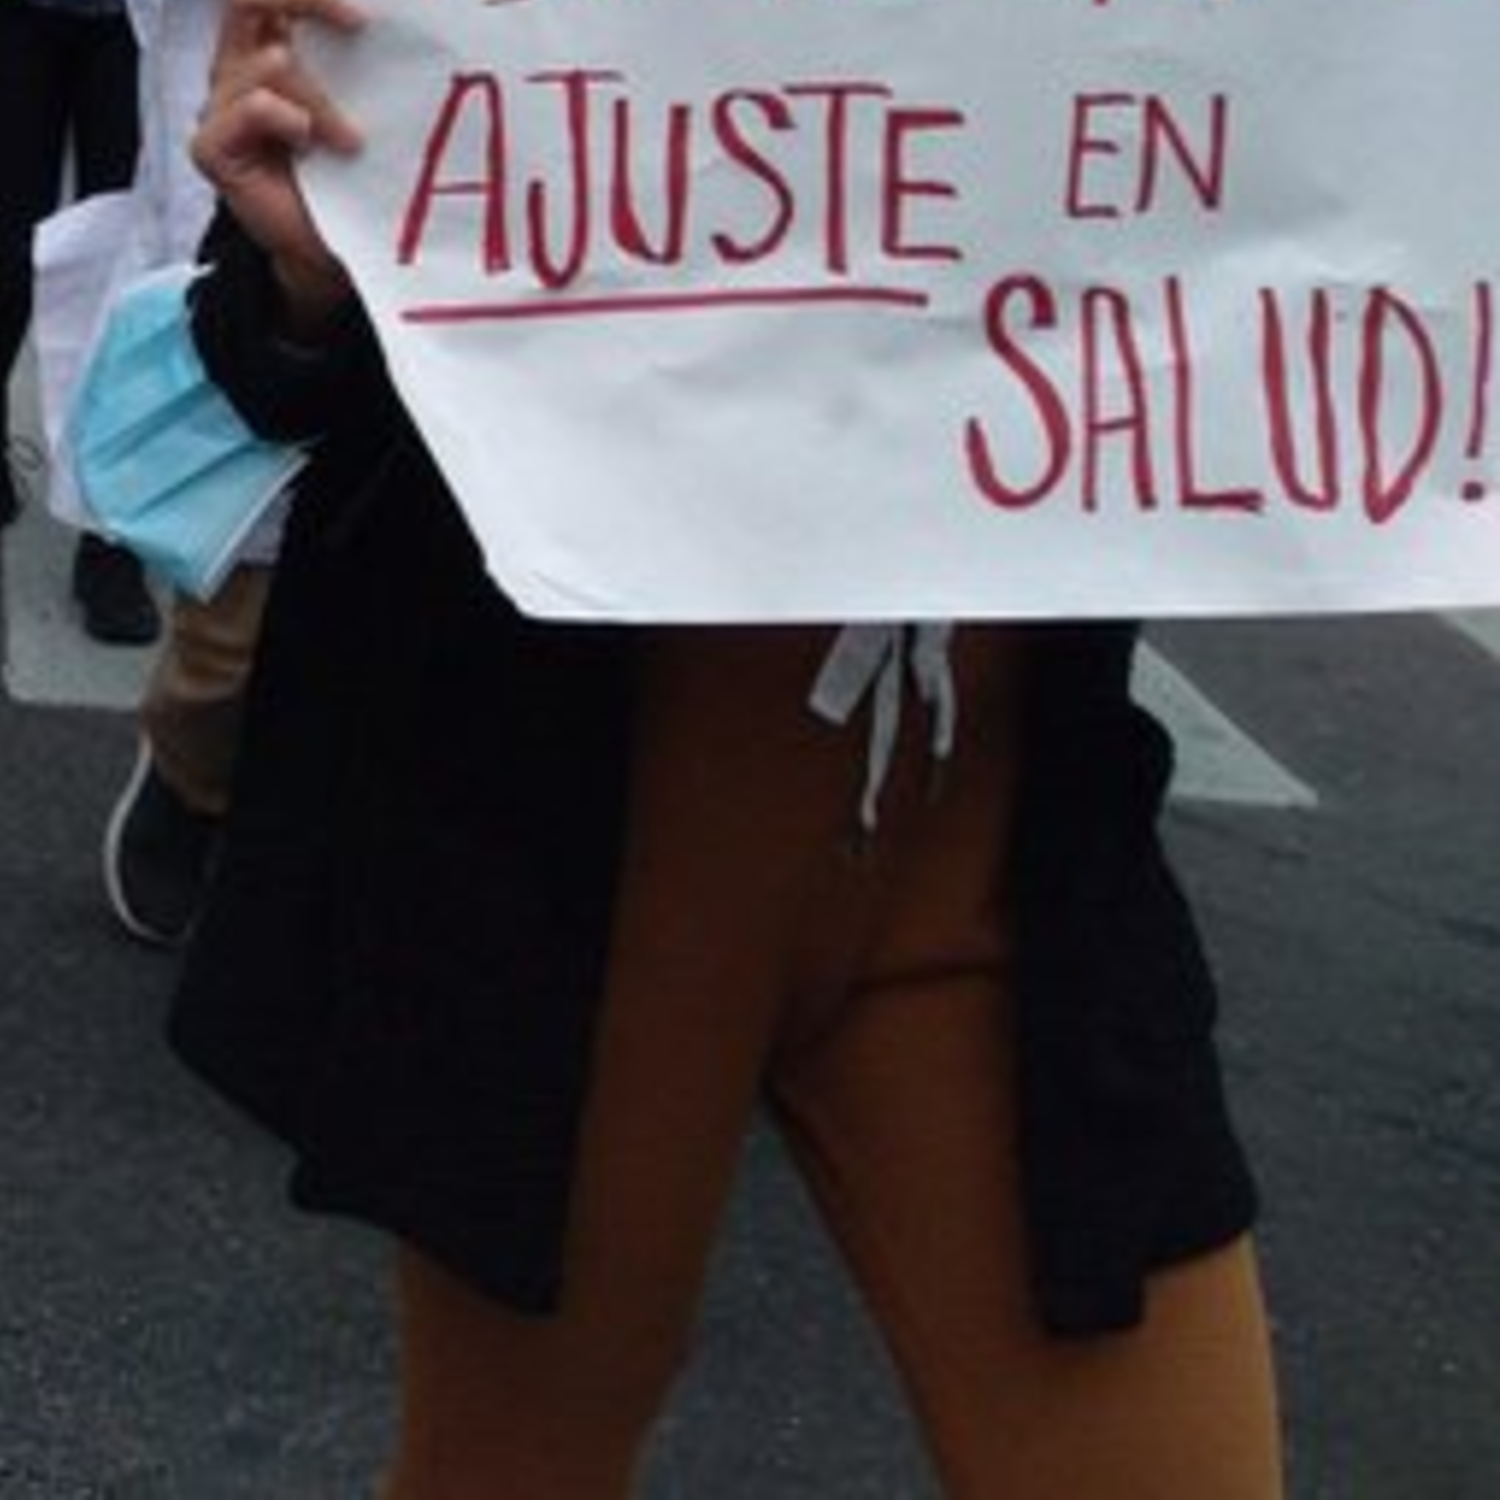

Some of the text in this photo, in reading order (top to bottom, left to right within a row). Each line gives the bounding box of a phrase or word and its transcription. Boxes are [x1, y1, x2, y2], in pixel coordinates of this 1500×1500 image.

[396, 70, 1228, 290] AJUSTE EN
[966, 274, 1492, 524] SALUD!
